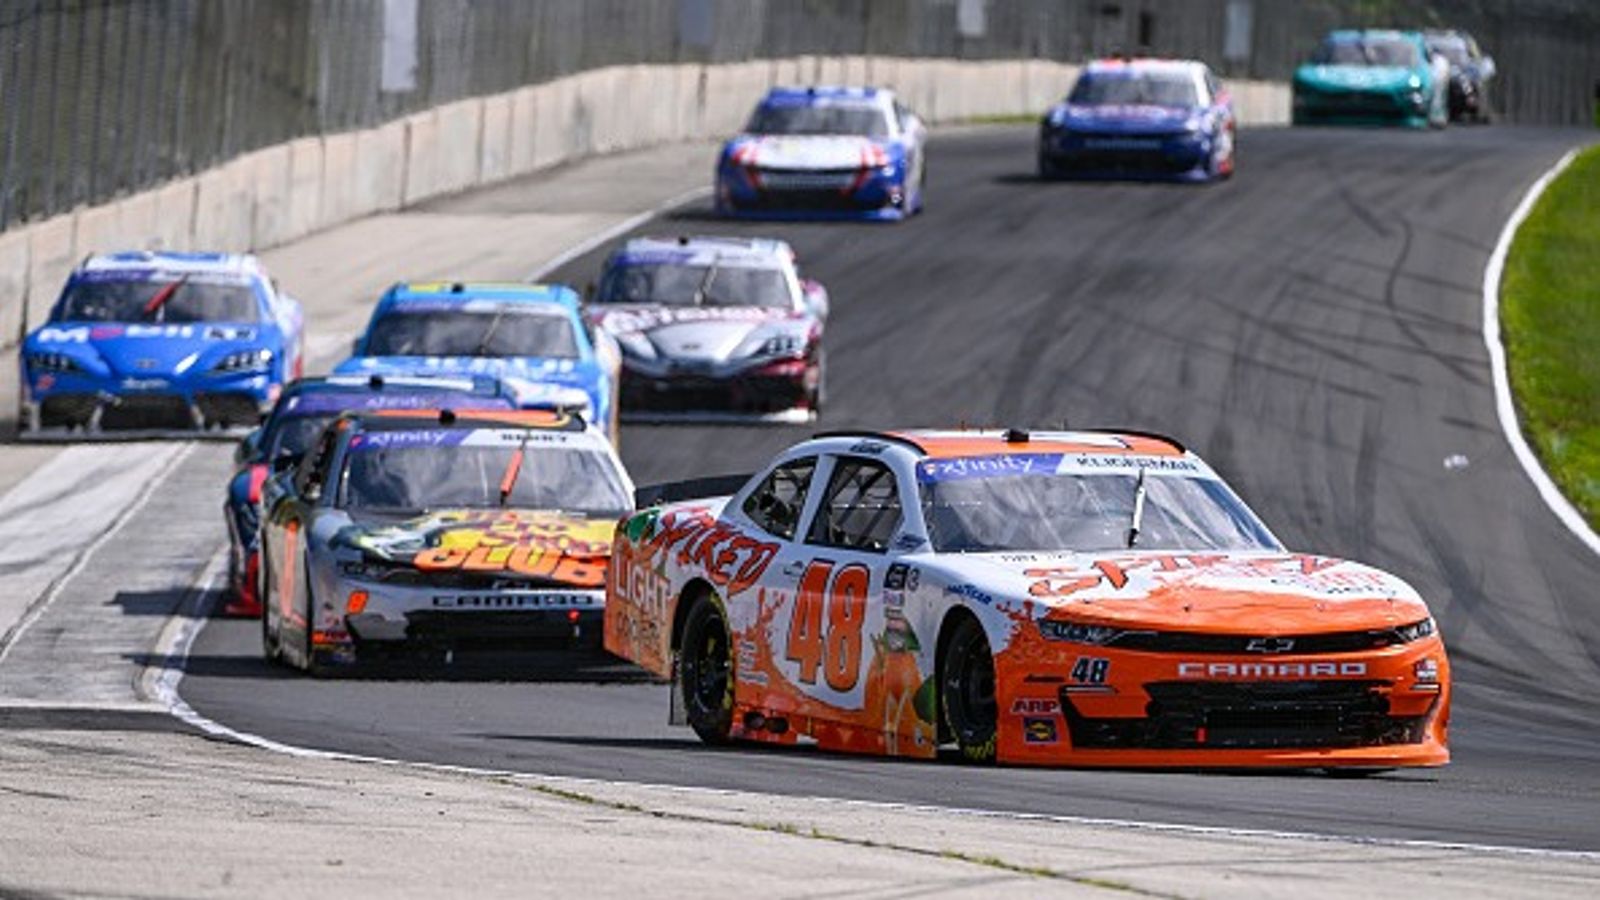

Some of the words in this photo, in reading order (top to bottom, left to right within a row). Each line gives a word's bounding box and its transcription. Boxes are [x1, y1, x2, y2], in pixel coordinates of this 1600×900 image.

[367, 430, 449, 447] xfinity
[940, 454, 1035, 477] xfinity
[614, 549, 671, 623] LIGHT
[432, 595, 593, 607] CAMARO
[785, 557, 871, 694] 48
[1069, 655, 1111, 684] 48
[1177, 662, 1367, 678] CAMARO
[1011, 698, 1062, 715] ARP
